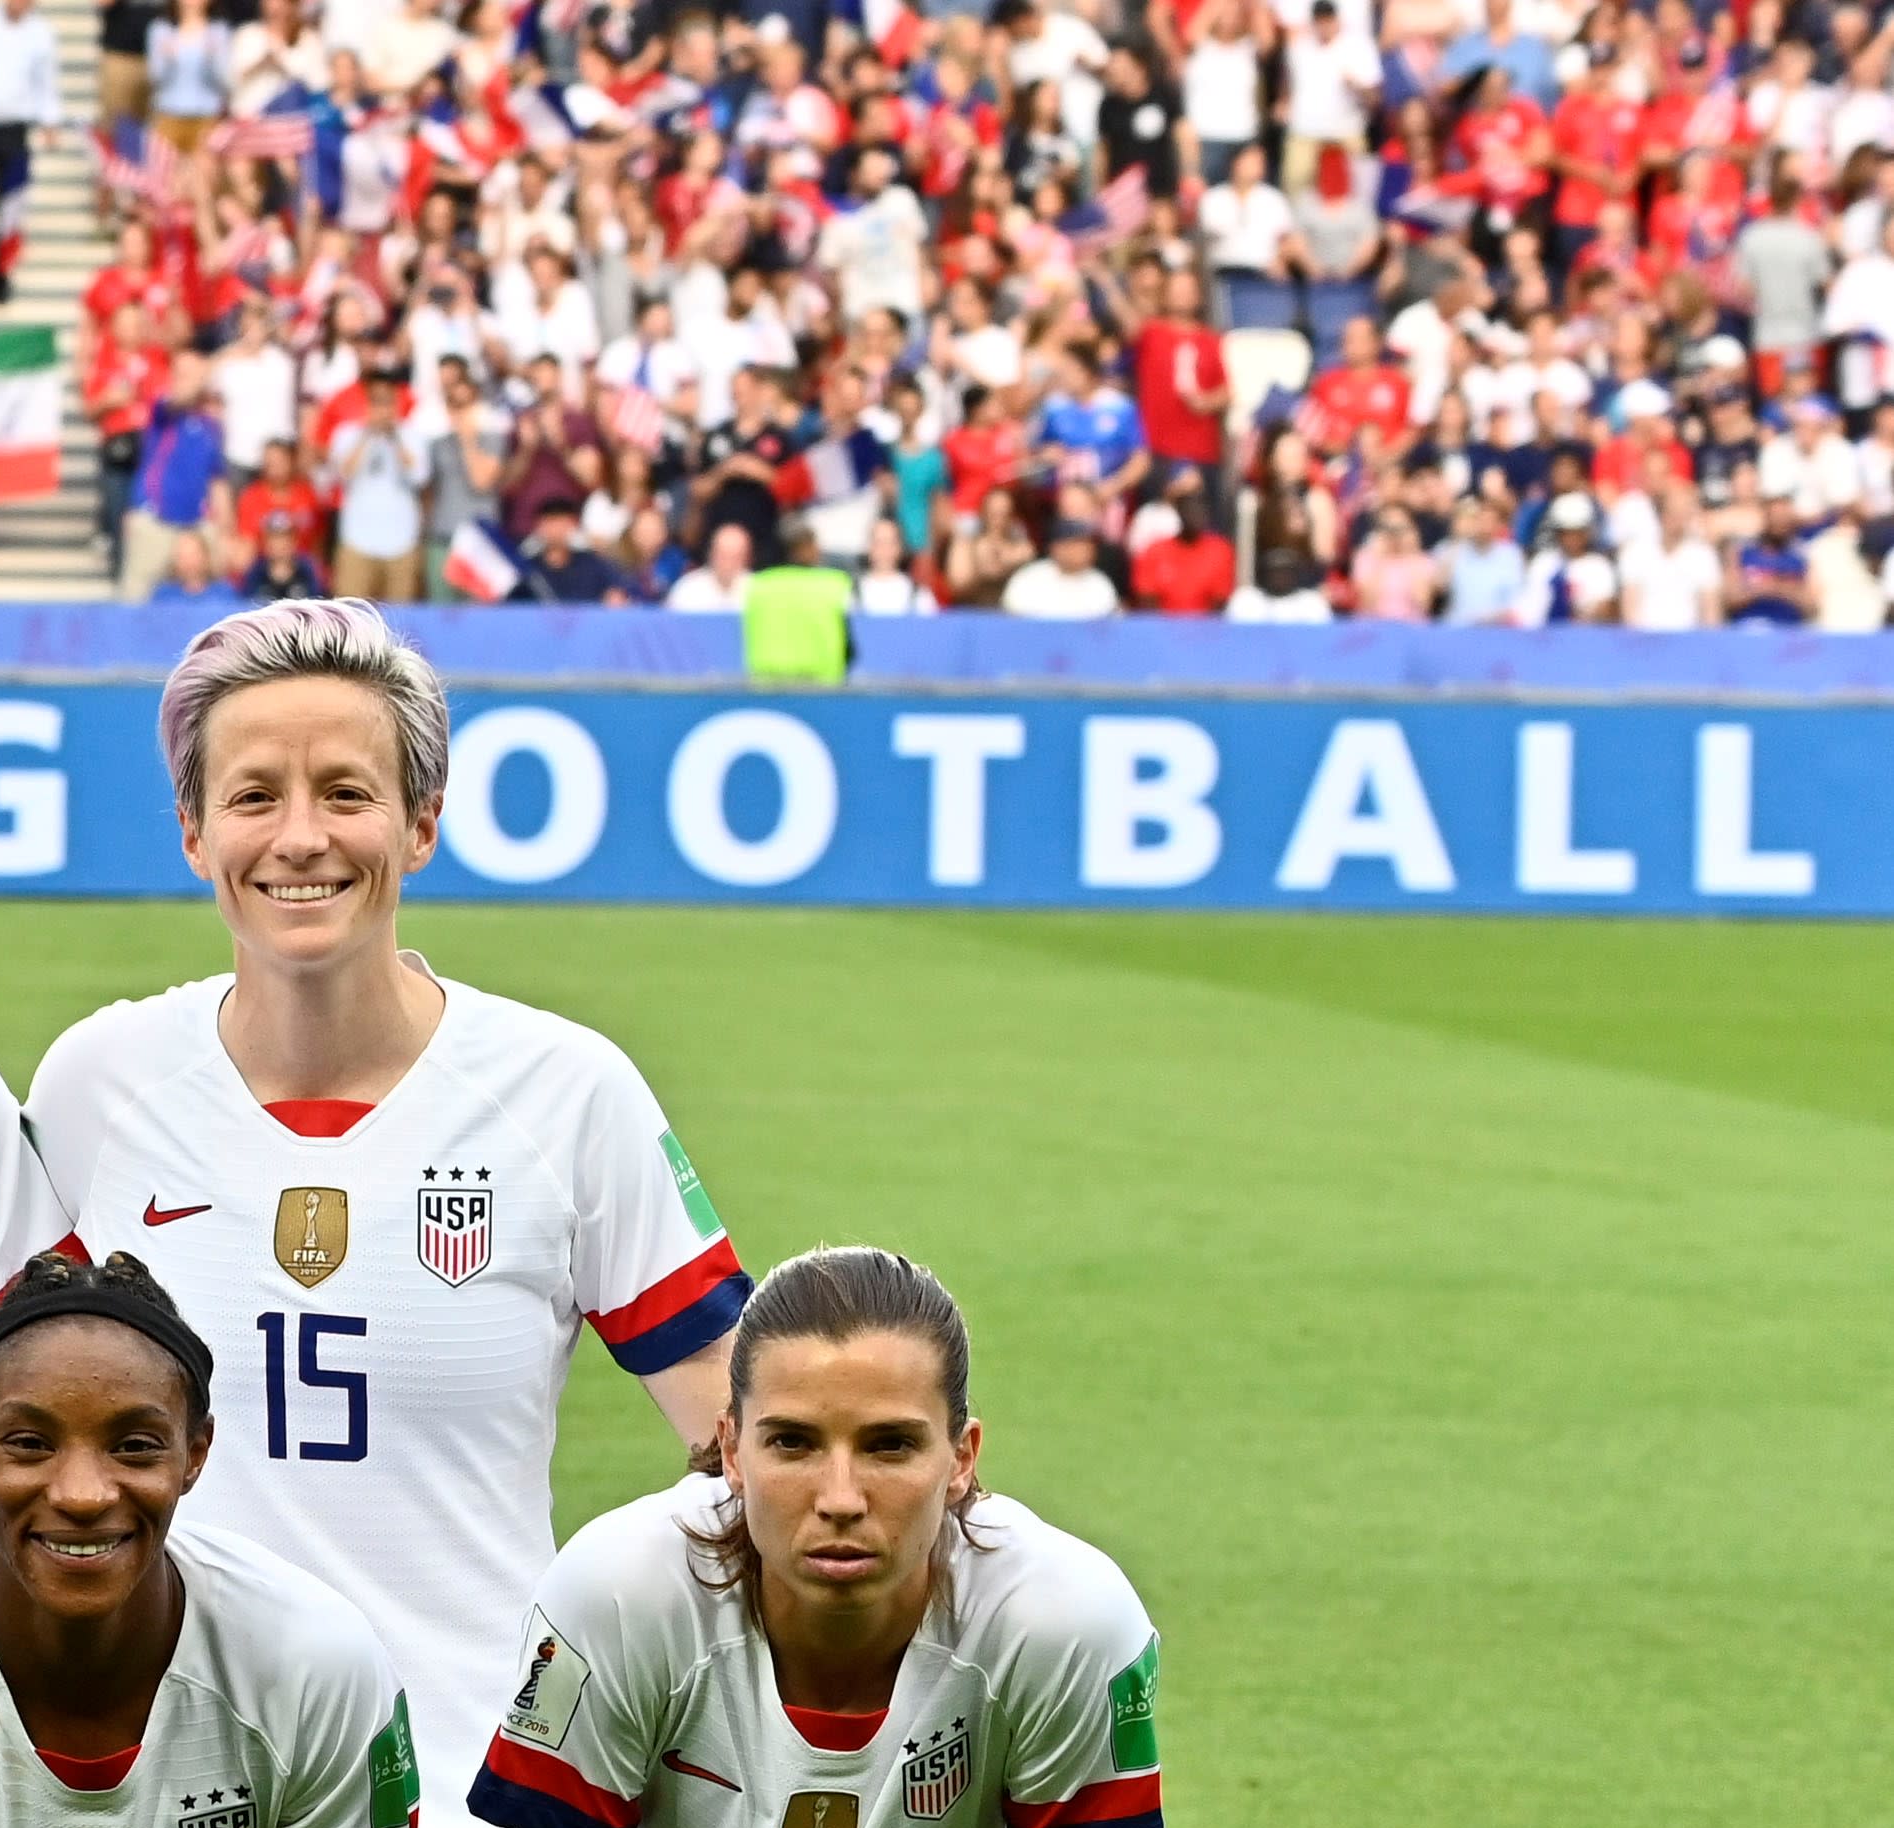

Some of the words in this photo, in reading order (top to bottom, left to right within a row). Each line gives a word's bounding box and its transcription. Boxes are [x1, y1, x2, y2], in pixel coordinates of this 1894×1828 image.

[444, 704, 1816, 897] OOTBALL
[425, 1196, 485, 1230] USA
[293, 1249, 326, 1262] FIFA
[257, 1310, 367, 1462] 15
[525, 1719, 549, 1736] 2019
[907, 1744, 967, 1783] USA
